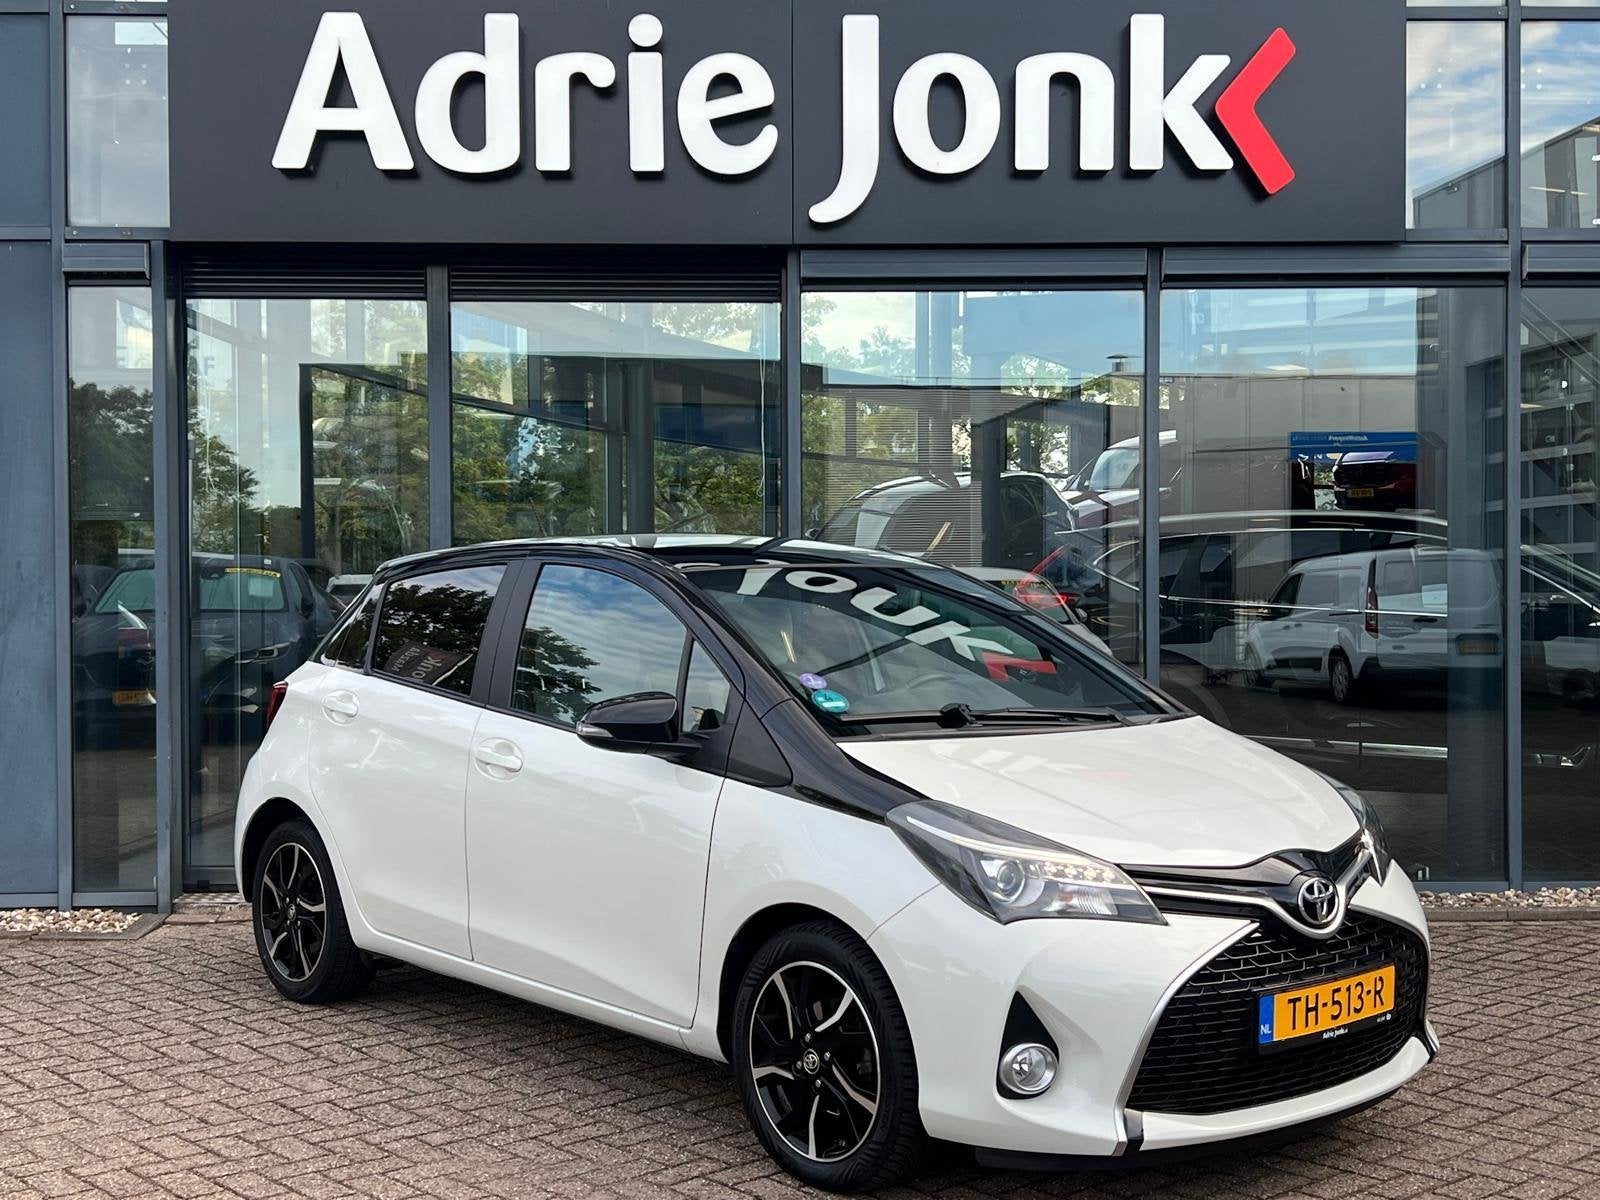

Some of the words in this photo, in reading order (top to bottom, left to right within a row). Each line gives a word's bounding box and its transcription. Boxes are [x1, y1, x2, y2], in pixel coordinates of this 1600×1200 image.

[271, 12, 778, 174] Adrie
[808, 13, 1234, 223] Jonk
[1260, 1024, 1272, 1035] NL
[1288, 975, 1385, 1031] TH-513-R
